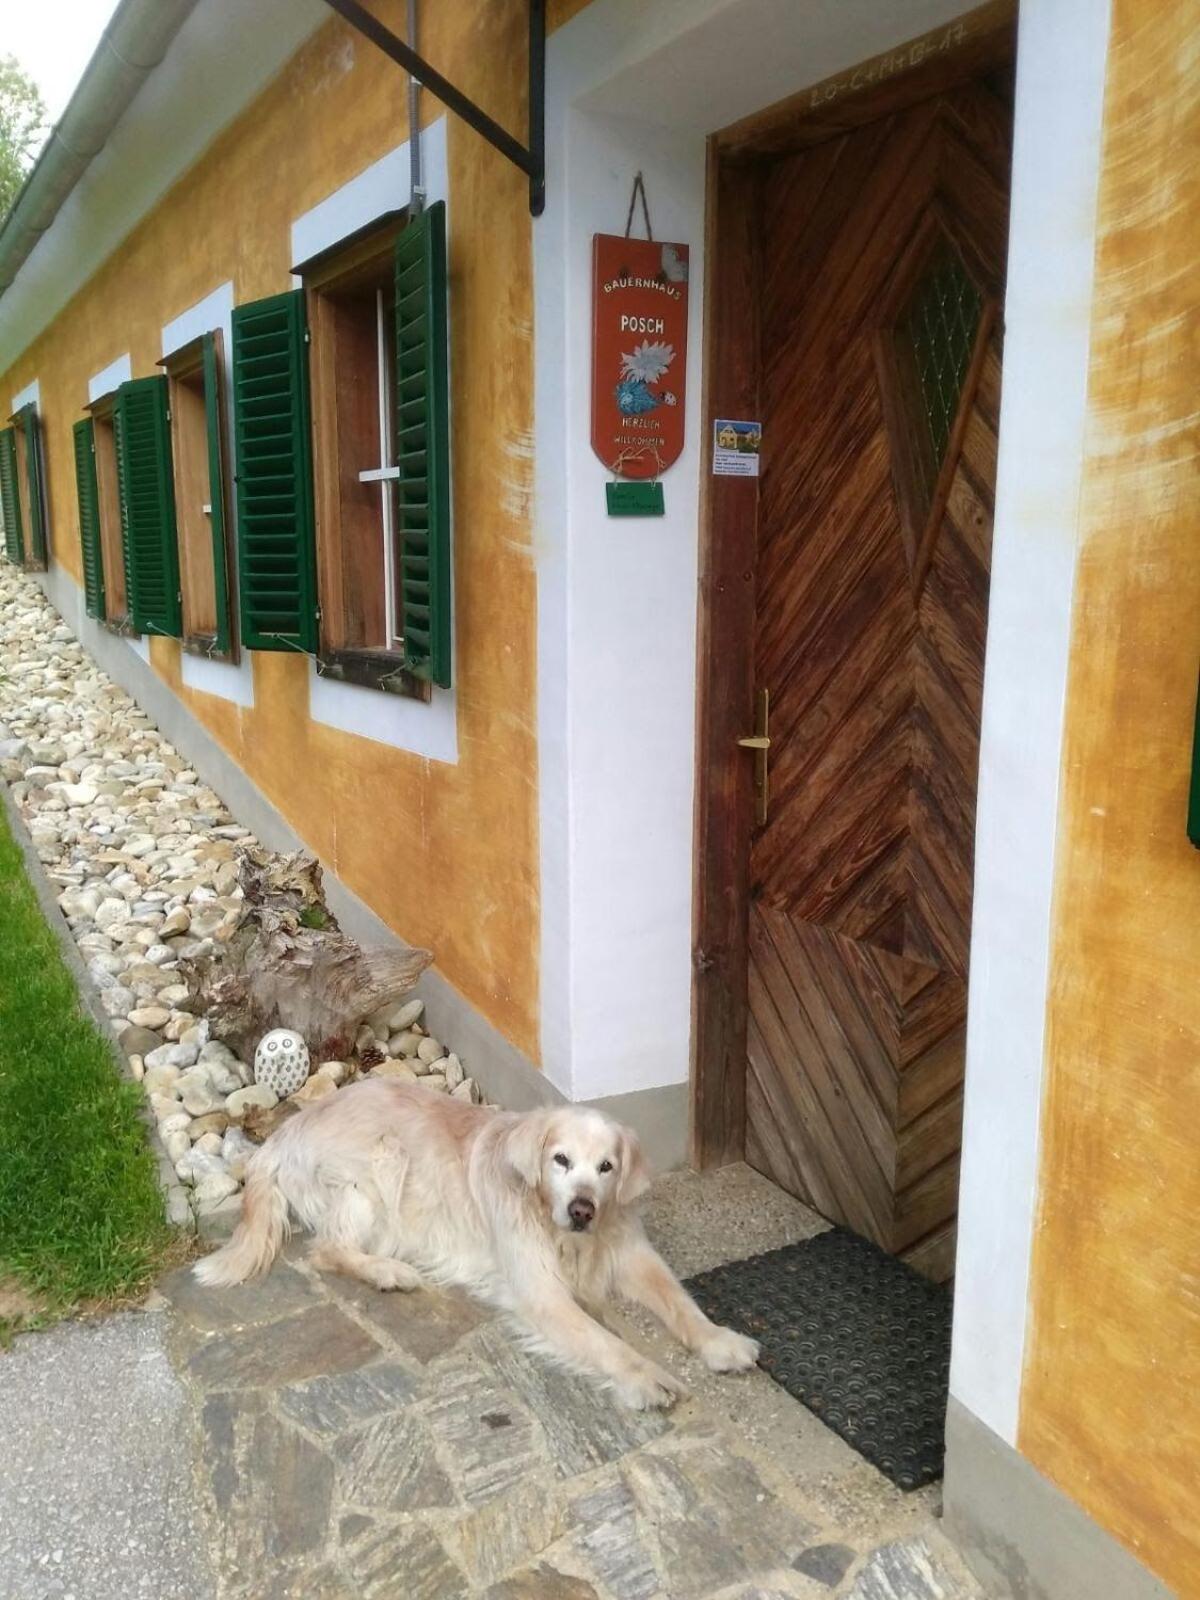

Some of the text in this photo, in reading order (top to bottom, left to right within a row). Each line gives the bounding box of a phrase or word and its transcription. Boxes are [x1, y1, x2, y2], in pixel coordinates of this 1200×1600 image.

[603, 277, 682, 301] BAUERNHAUS
[621, 315, 664, 334] POSCH
[622, 417, 660, 430] HERZLICH
